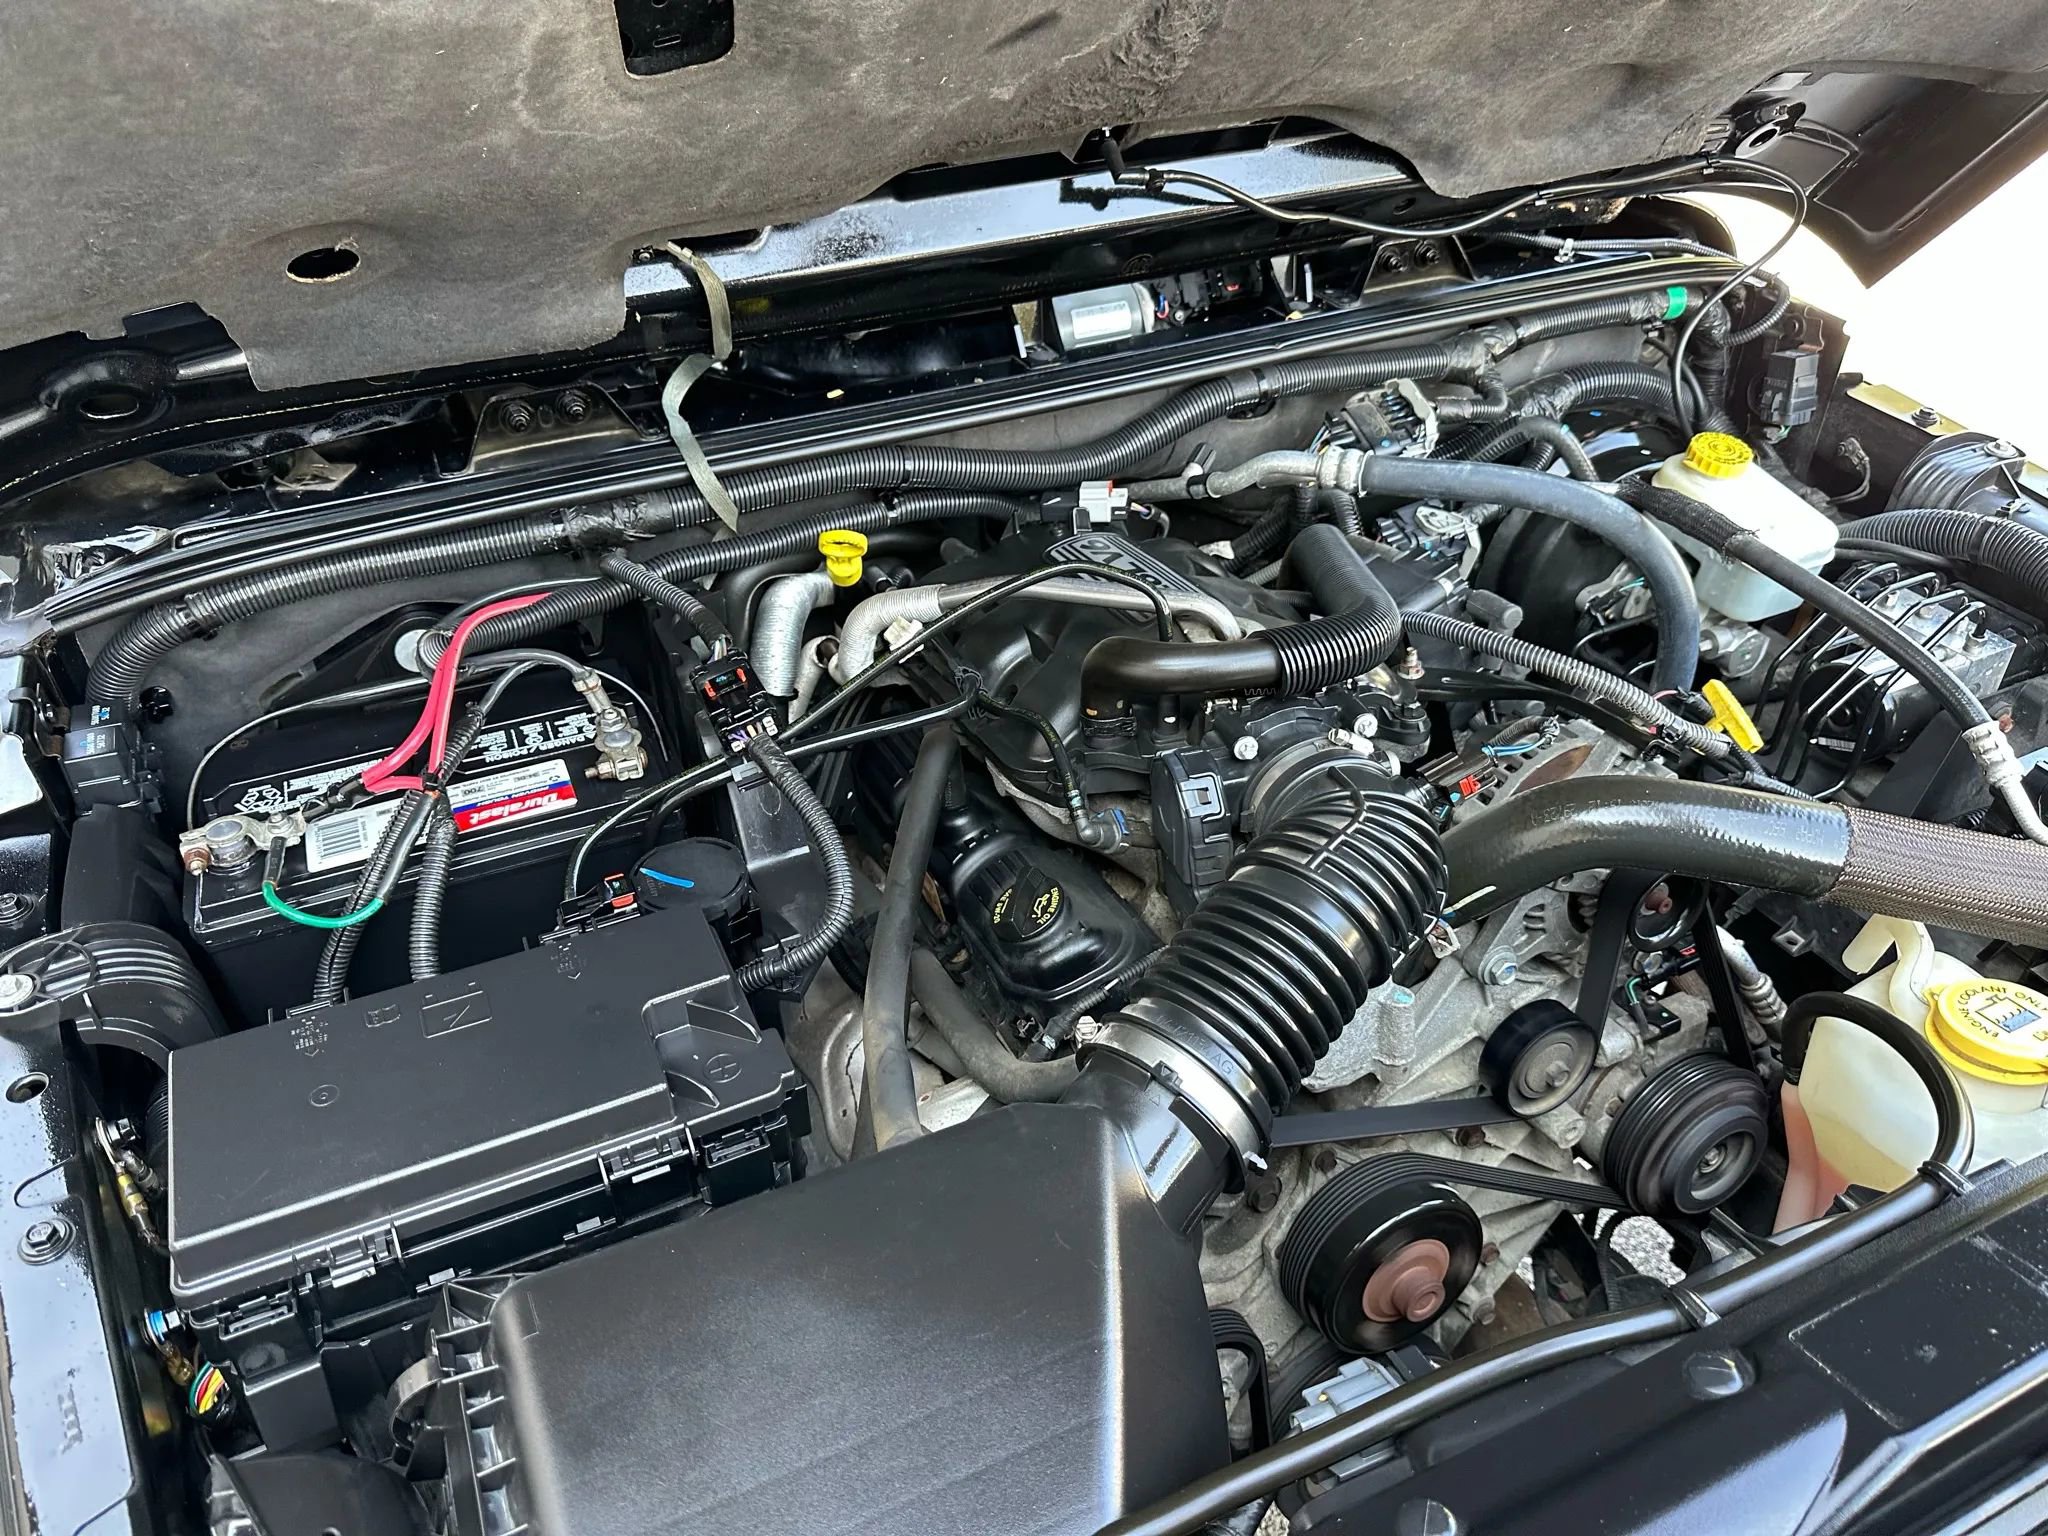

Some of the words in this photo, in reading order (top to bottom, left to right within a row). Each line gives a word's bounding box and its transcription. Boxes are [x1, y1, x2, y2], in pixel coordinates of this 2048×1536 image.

[463, 785, 484, 796] 700
[469, 792, 558, 825] Duralast
[1047, 887, 1060, 913] ENGINE
[1036, 913, 1051, 925] OIL
[1957, 985, 2007, 1005] COOLANT
[1958, 1007, 1999, 1038] ENGINE
